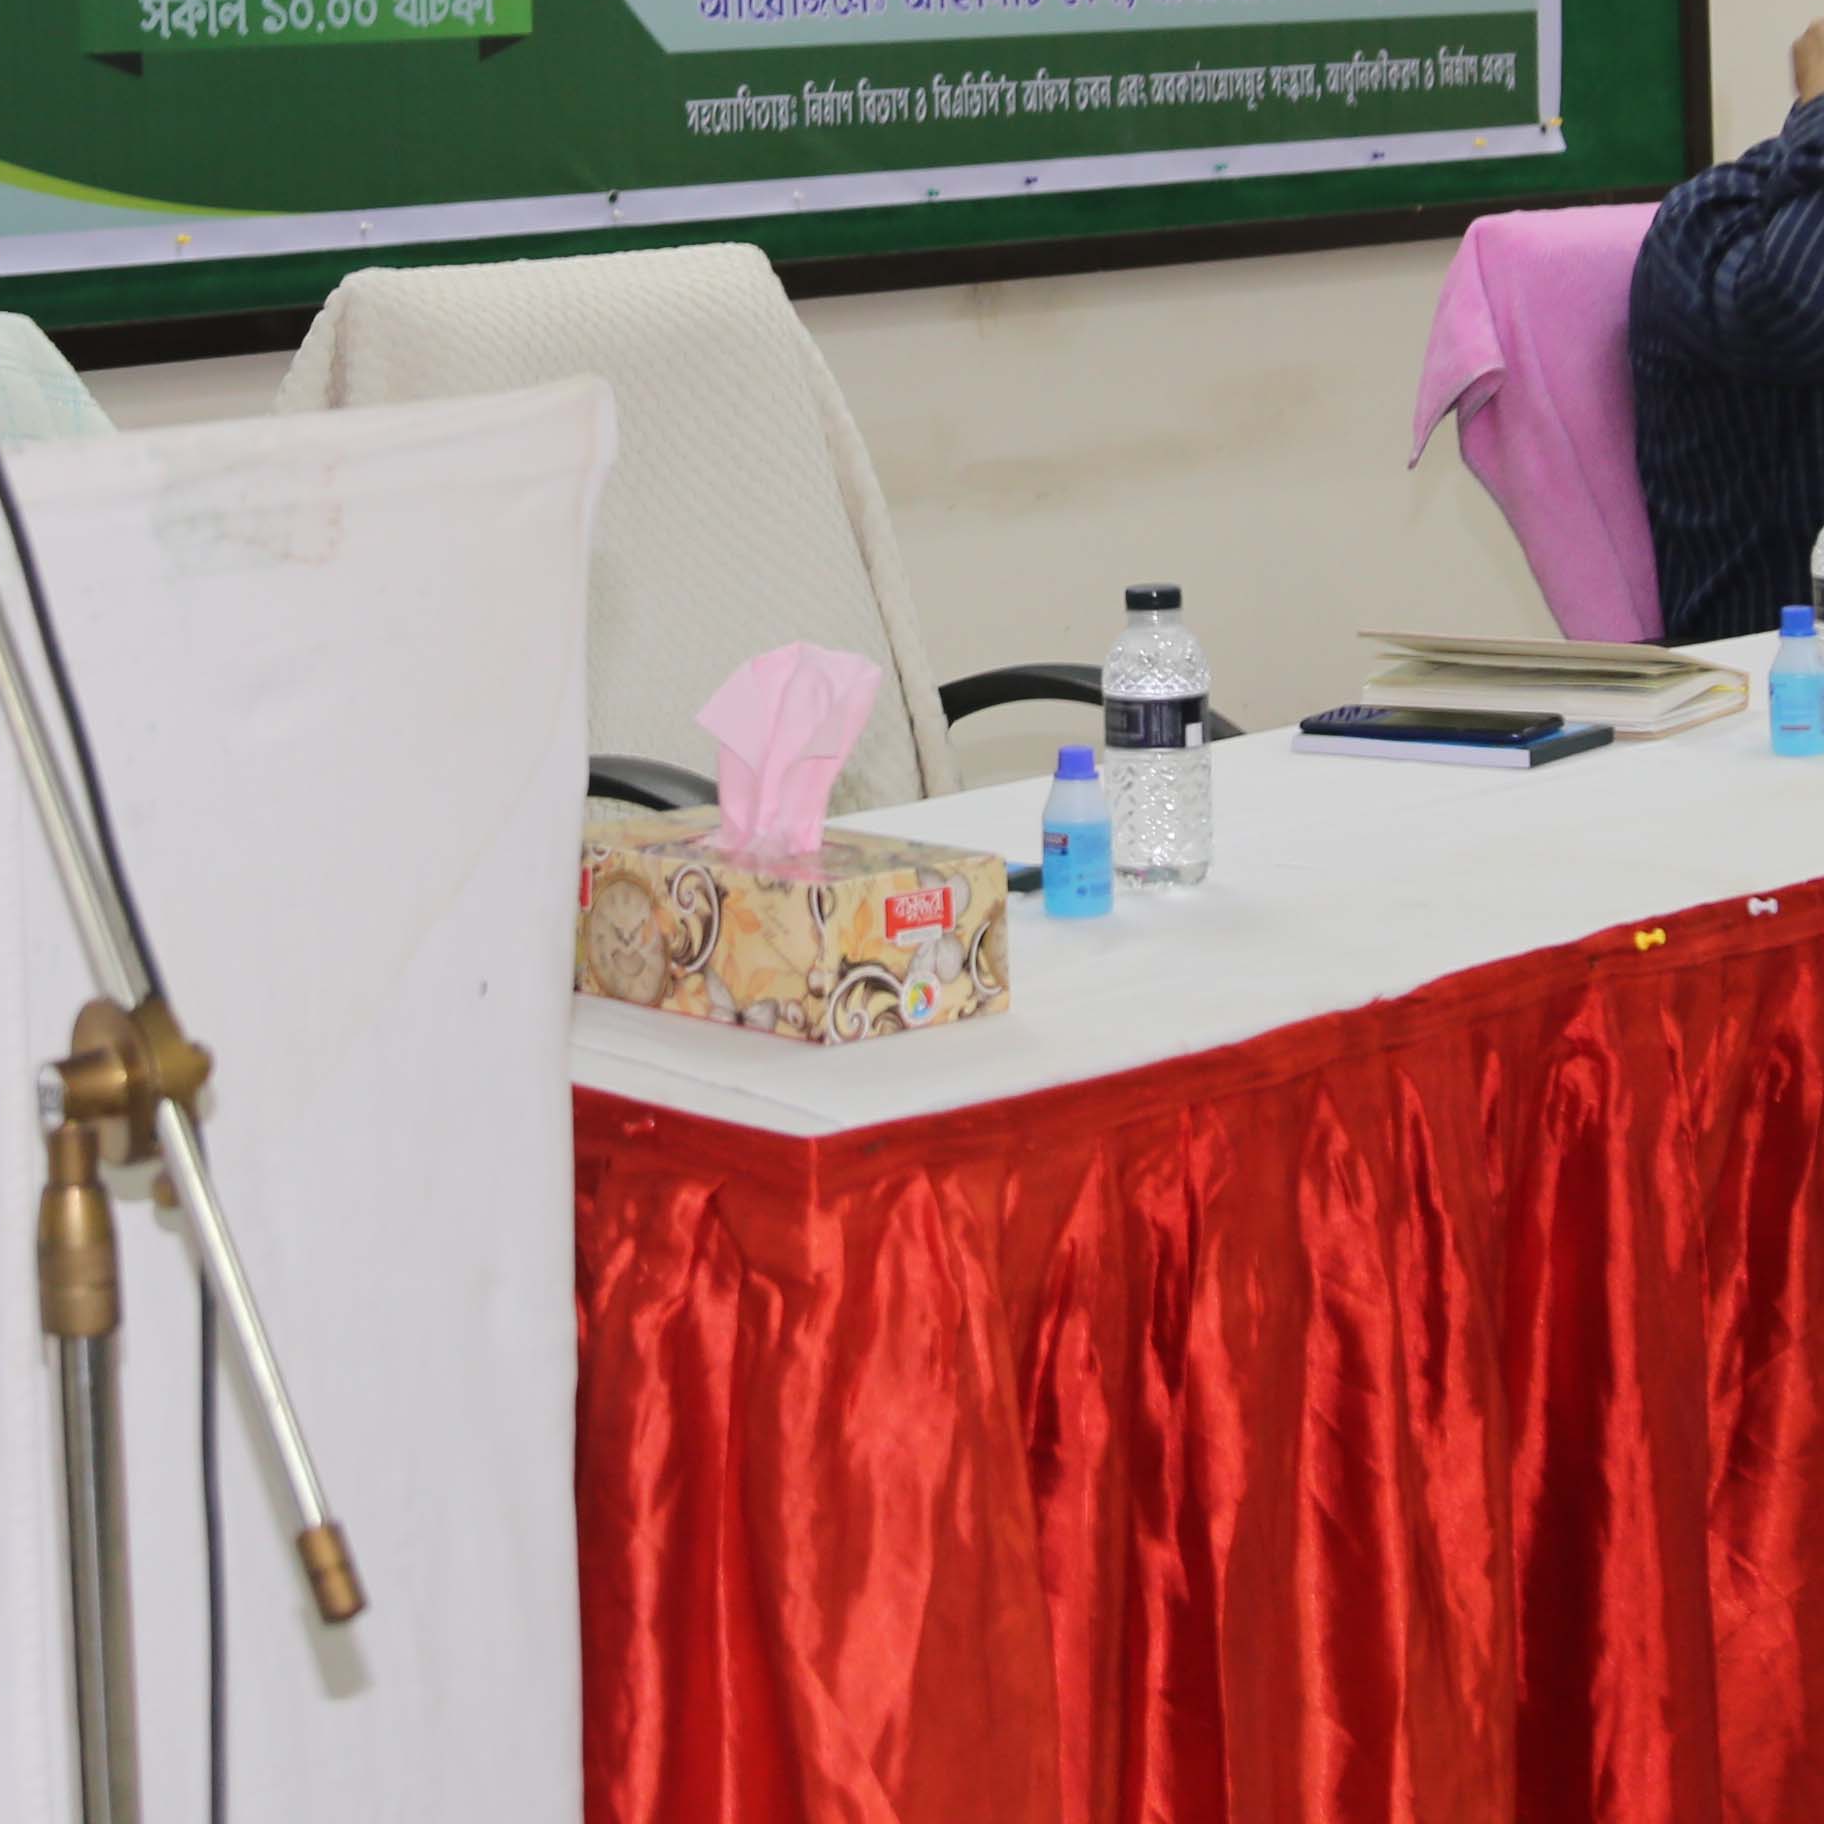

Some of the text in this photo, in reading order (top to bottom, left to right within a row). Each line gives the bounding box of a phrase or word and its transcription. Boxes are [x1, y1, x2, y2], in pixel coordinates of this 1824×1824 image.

[803, 78, 854, 127] নির্মাণ
[858, 77, 910, 124] বিভাগ
[915, 86, 927, 123] ও
[1022, 67, 1071, 113] অফিস
[1074, 75, 1112, 111] ভবন
[1424, 57, 1435, 91] ও
